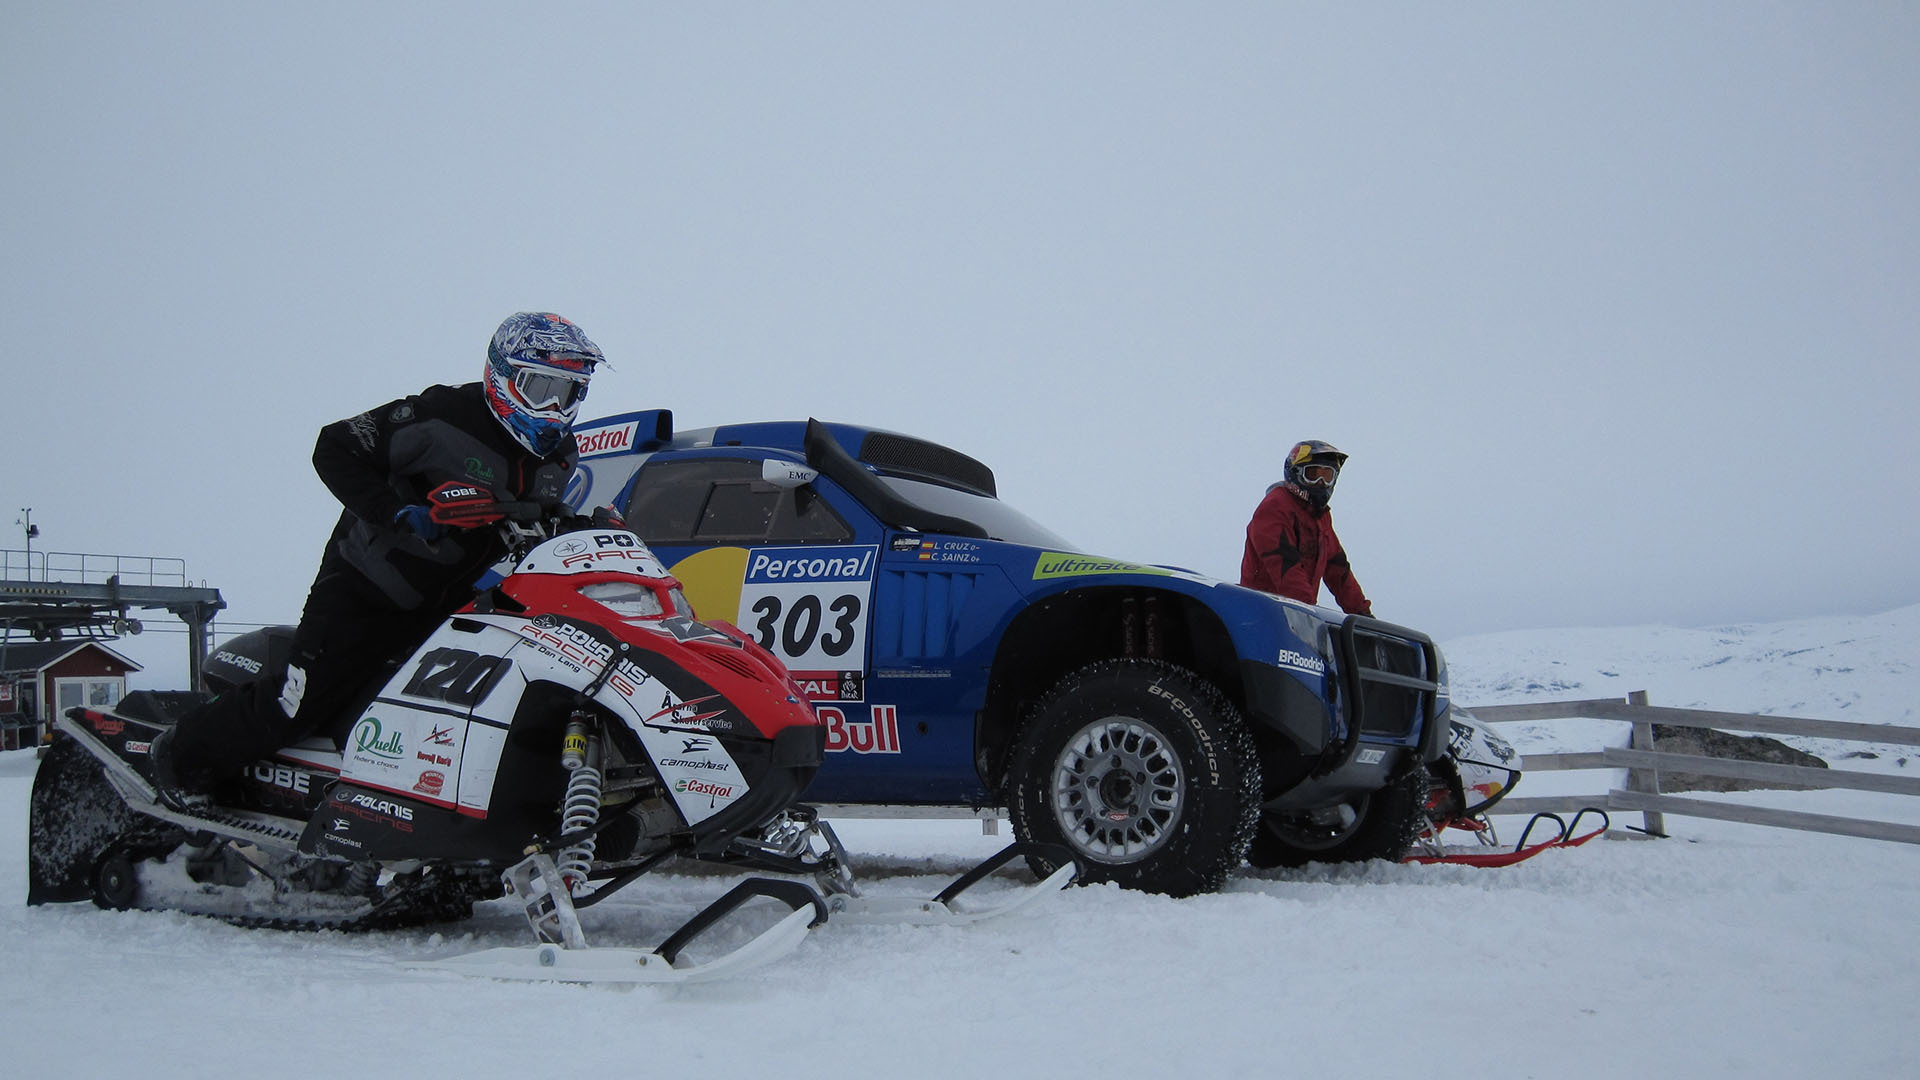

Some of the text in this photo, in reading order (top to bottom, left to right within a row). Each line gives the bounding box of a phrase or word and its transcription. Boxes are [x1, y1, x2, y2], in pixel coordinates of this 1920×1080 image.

[441, 487, 478, 498] TOBE
[593, 534, 638, 548] PO
[944, 542, 970, 551] CRUZ
[562, 550, 656, 569] RAC
[749, 550, 872, 579] Personal
[942, 552, 970, 562] SAINZ
[1042, 559, 1141, 574] ultimate
[747, 594, 862, 657] 303
[215, 650, 263, 674] POLARIS
[538, 646, 581, 674] Dan Lang
[1278, 649, 1325, 672] BFGoodrich
[401, 647, 513, 708] 120
[793, 681, 835, 694] TAL
[355, 717, 405, 758] Duells
[818, 705, 900, 753] Bull
[1147, 684, 1220, 786] BFGoodrich
[354, 755, 400, 770] Riders choice
[660, 758, 730, 772] camoplast
[687, 779, 733, 797] Castrol
[328, 800, 414, 833] RACING
[351, 793, 415, 821] POLARIS
[324, 832, 363, 849] camoplast
